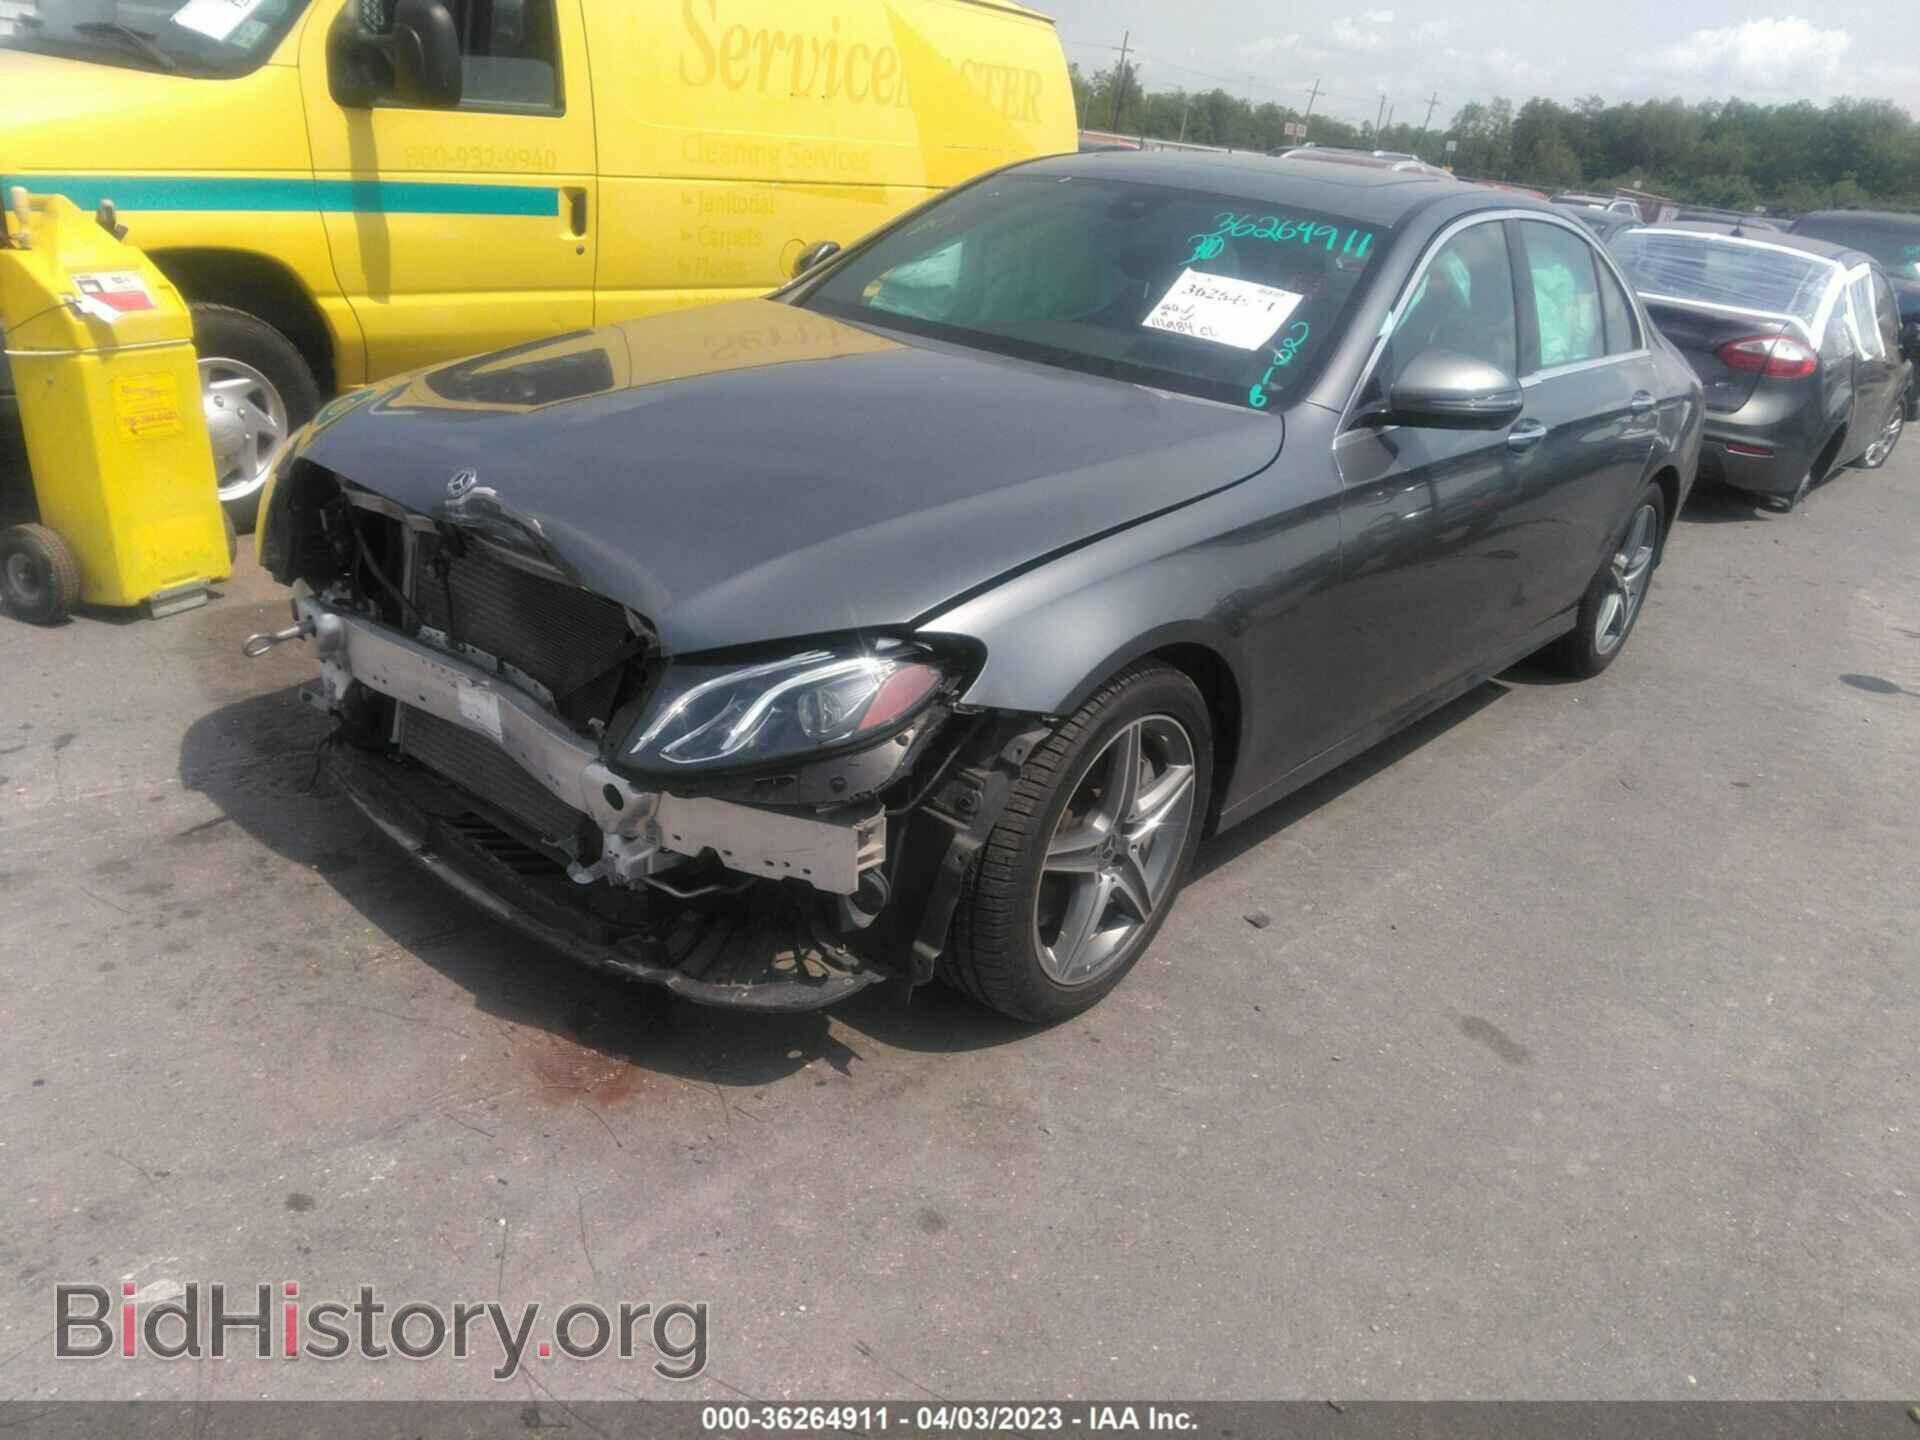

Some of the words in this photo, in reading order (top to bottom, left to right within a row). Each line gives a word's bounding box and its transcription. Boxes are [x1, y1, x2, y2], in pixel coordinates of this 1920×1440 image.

[681, 133, 780, 172] Cleaning
[788, 141, 871, 172] Services
[697, 190, 775, 216] Janitorial
[1211, 212, 1373, 257] 36264911
